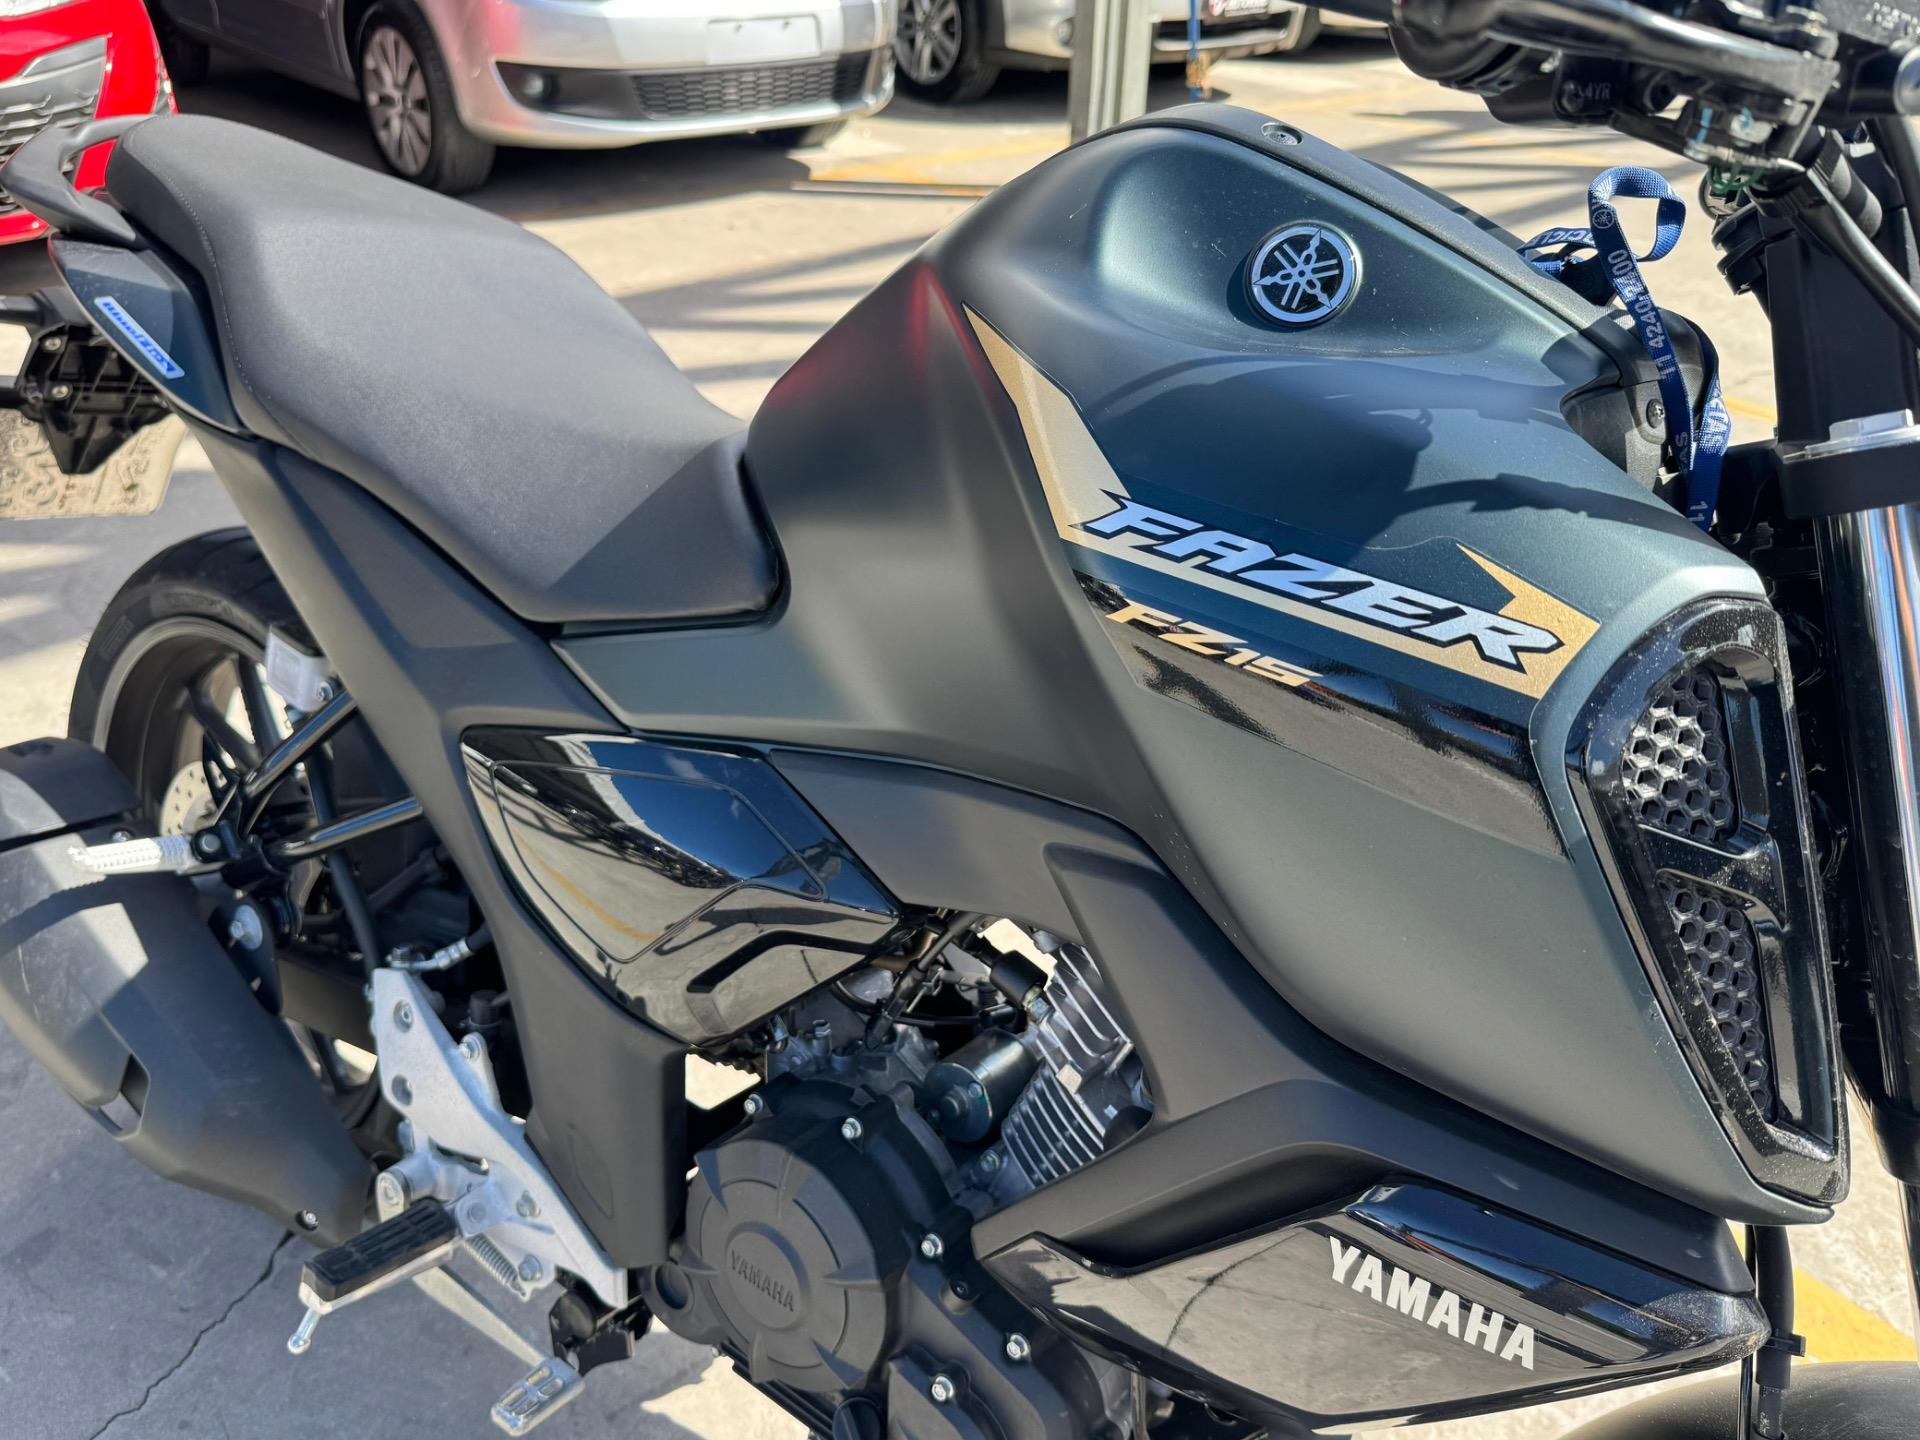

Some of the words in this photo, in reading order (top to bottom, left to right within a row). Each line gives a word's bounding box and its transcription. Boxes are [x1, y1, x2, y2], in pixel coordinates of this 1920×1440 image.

[1079, 495, 1561, 668] FAZER
[1105, 598, 1324, 688] FZ15
[730, 1248, 795, 1313] YAMAHA
[1329, 1235, 1535, 1371] YAMAHA
